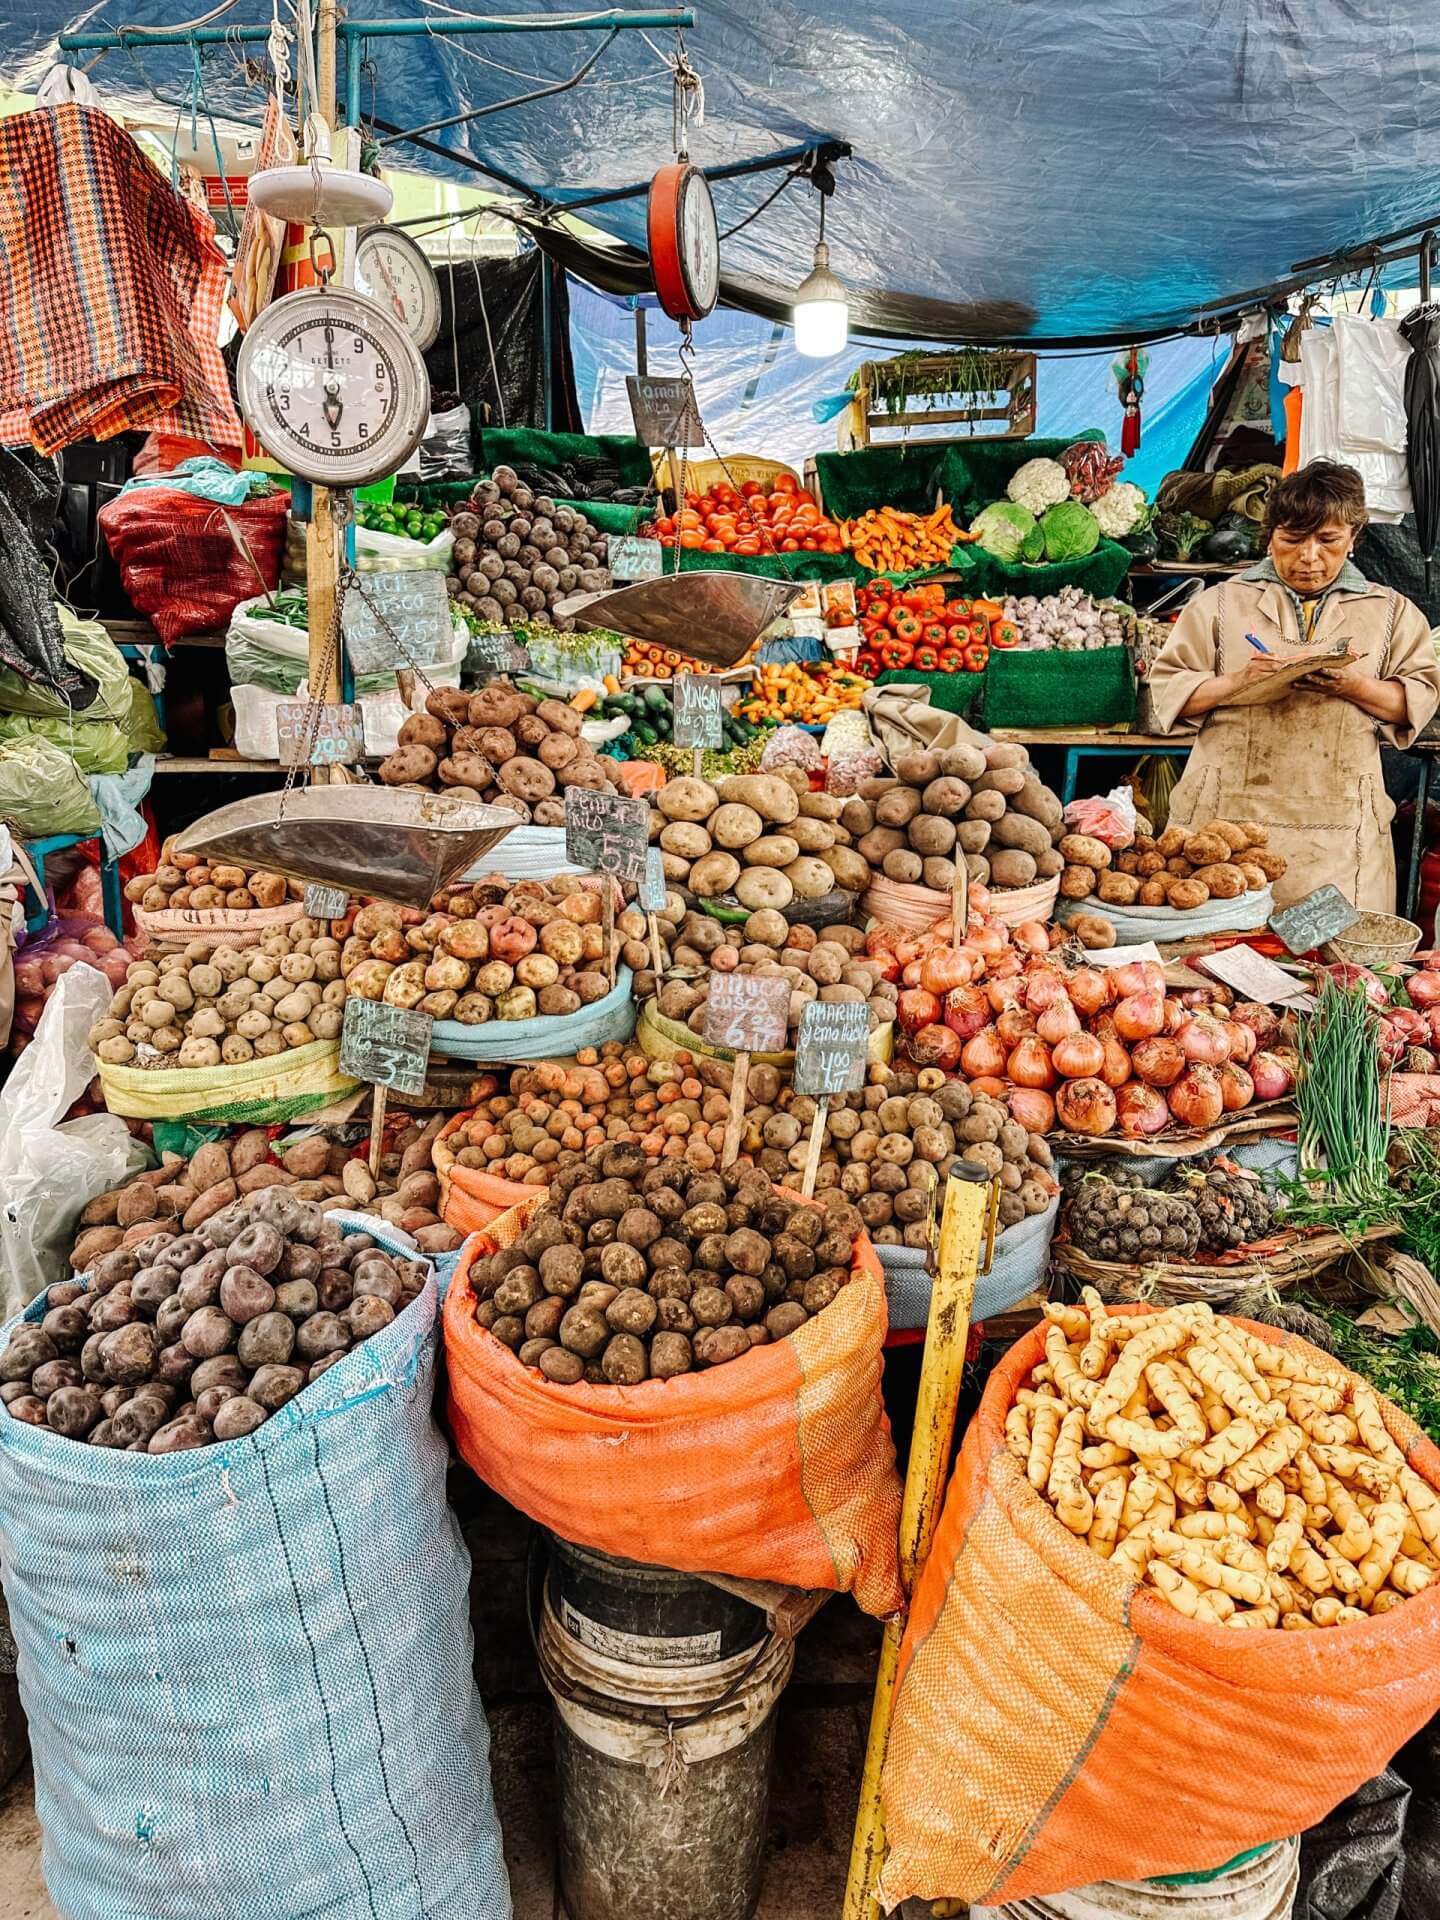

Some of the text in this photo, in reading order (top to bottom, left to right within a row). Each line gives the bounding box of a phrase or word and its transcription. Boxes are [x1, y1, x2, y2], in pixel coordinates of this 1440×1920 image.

[324, 327, 334, 343] 0
[297, 337, 303, 353] 1
[354, 338, 364, 354] 9
[311, 357, 351, 365] DETCTO
[375, 363, 385, 379] 8
[279, 394, 290, 411] 3
[379, 399, 389, 415] 7
[299, 422, 310, 438] 4
[358, 422, 369, 438] 6
[331, 431, 342, 447] 5
